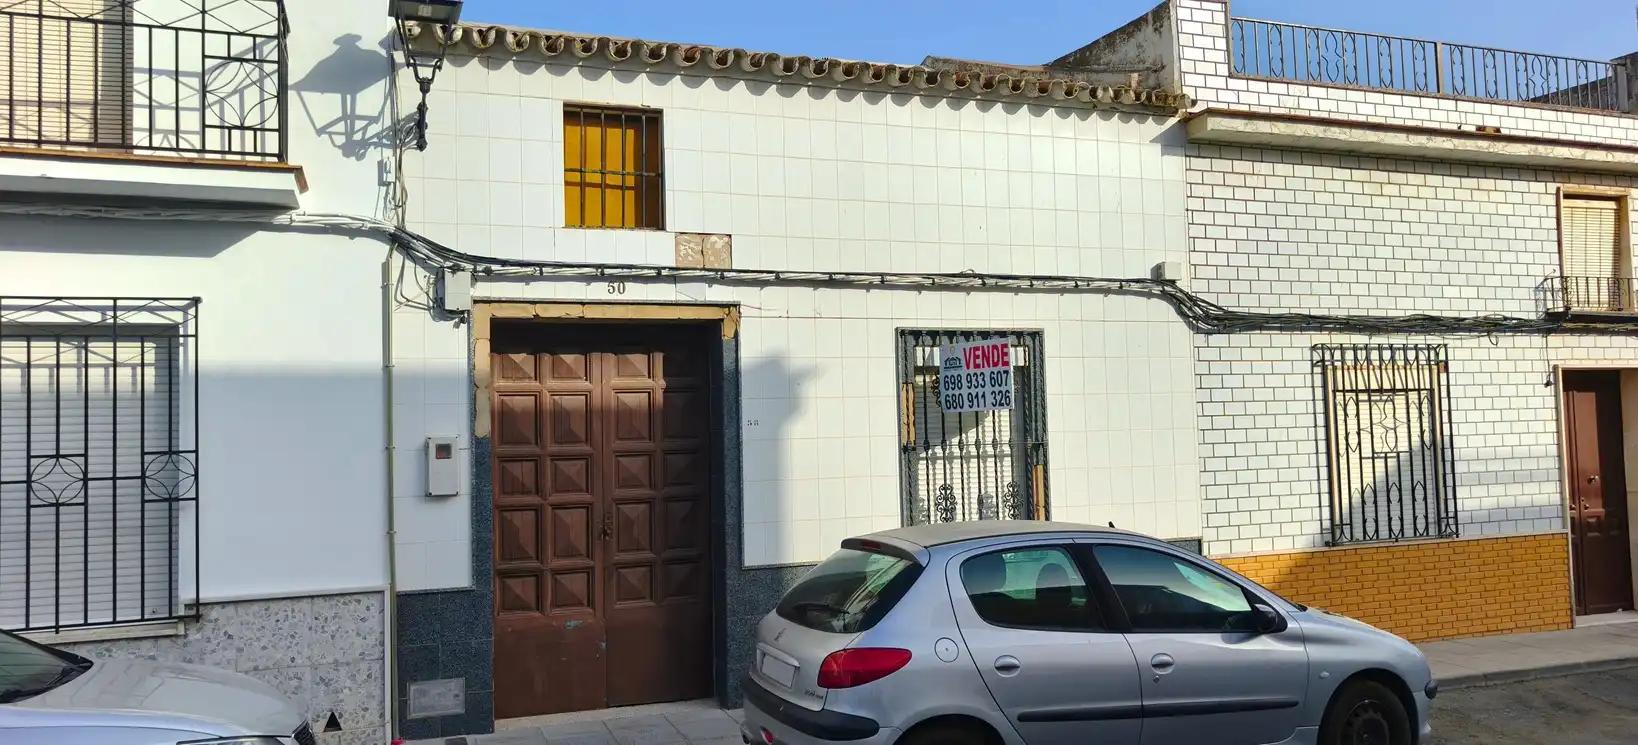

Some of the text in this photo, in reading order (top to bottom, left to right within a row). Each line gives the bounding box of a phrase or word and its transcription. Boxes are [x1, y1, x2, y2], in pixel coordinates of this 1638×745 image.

[607, 280, 626, 295] 50
[963, 343, 1010, 370] VENDE
[943, 370, 1009, 391] 698 933 607
[944, 389, 1011, 410] 680 911 326
